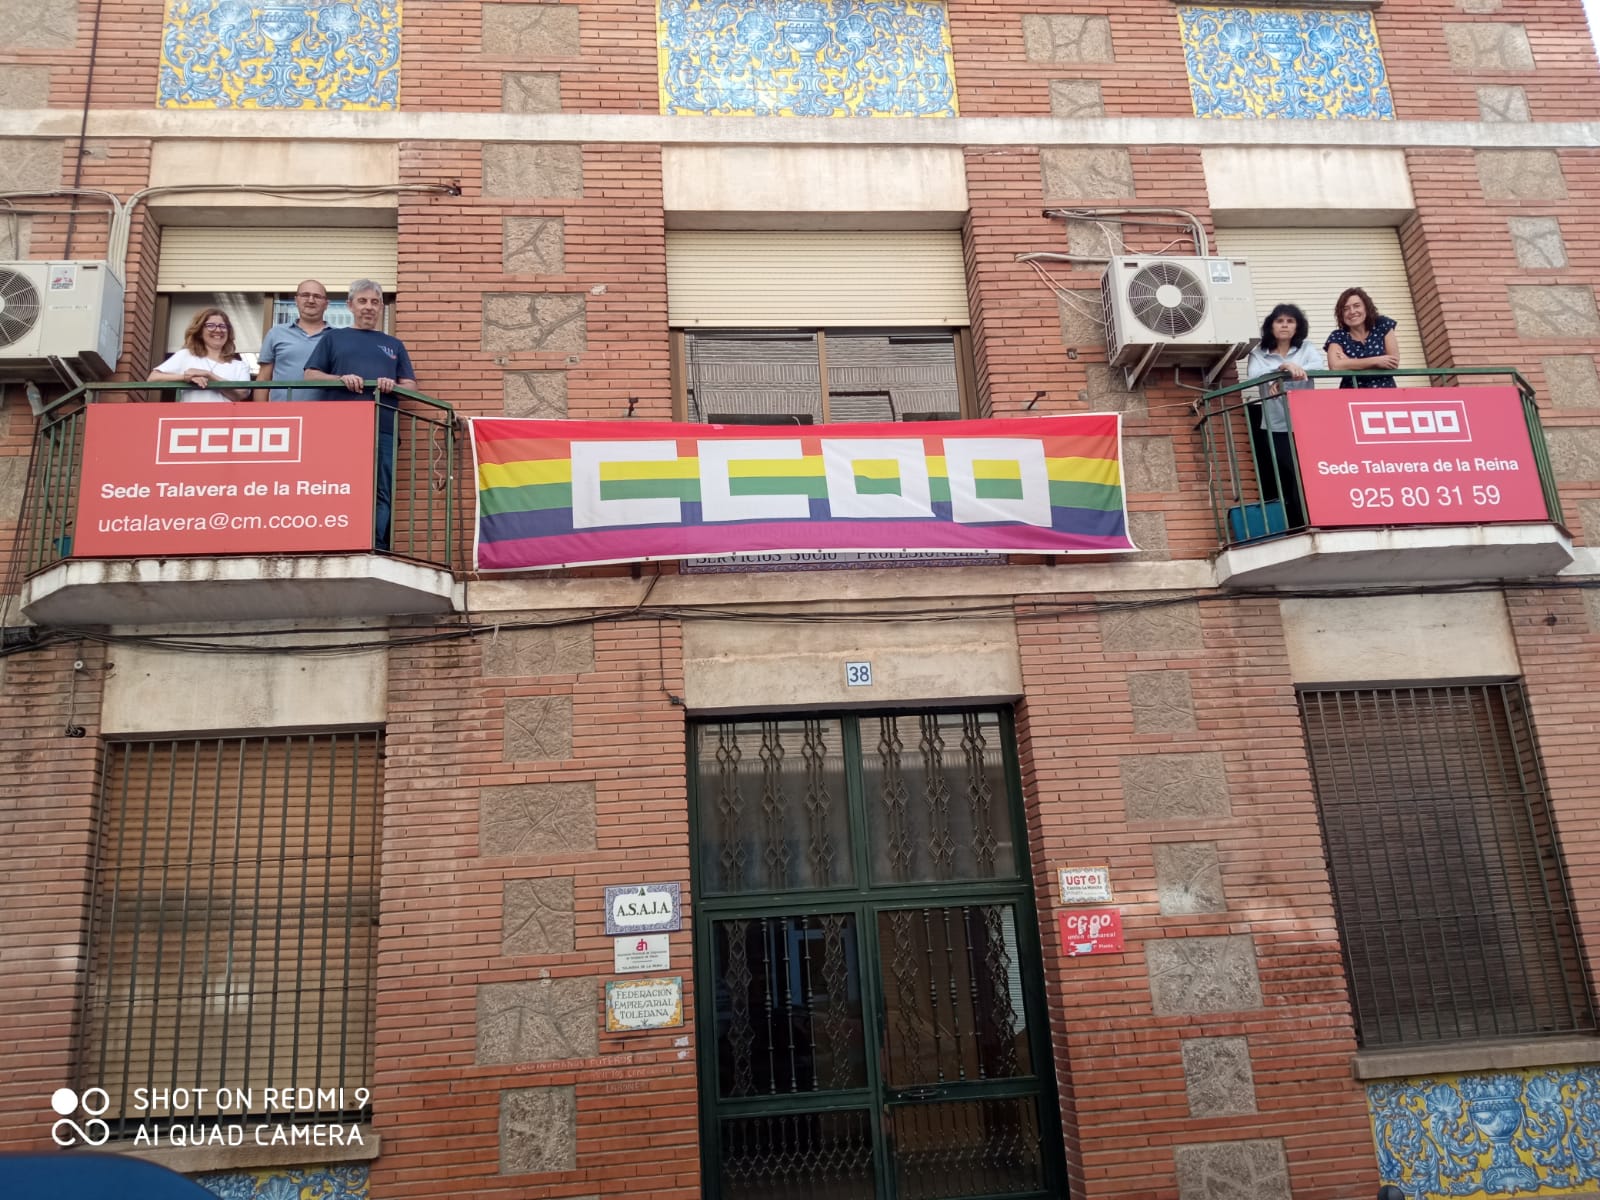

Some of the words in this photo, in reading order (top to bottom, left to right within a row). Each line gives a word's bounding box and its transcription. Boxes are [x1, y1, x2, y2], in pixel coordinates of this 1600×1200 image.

[1360, 410, 1460, 435] CCOO
[169, 427, 290, 453] CCOO
[1317, 460, 1359, 475] Sede
[1361, 459, 1430, 474] Talavera
[1433, 458, 1453, 473] de
[1456, 458, 1471, 472] la
[1474, 457, 1519, 471] Reina
[101, 483, 151, 499] Sede
[156, 481, 238, 498] Talavera
[243, 481, 268, 497] de
[273, 480, 291, 496] la
[296, 479, 351, 496] Reina
[570, 437, 1053, 529] CCOO
[1350, 487, 1394, 508] 925
[1400, 486, 1430, 507] 80
[1437, 485, 1463, 506] 31
[1472, 484, 1501, 505] 59
[98, 512, 349, 533] uctalavera@cm.ccoo.es
[849, 665, 869, 682] 38
[1066, 875, 1086, 885] UGT
[616, 901, 671, 917] A.S.A.J.A.
[620, 1008, 670, 1020] TOLEDANA
